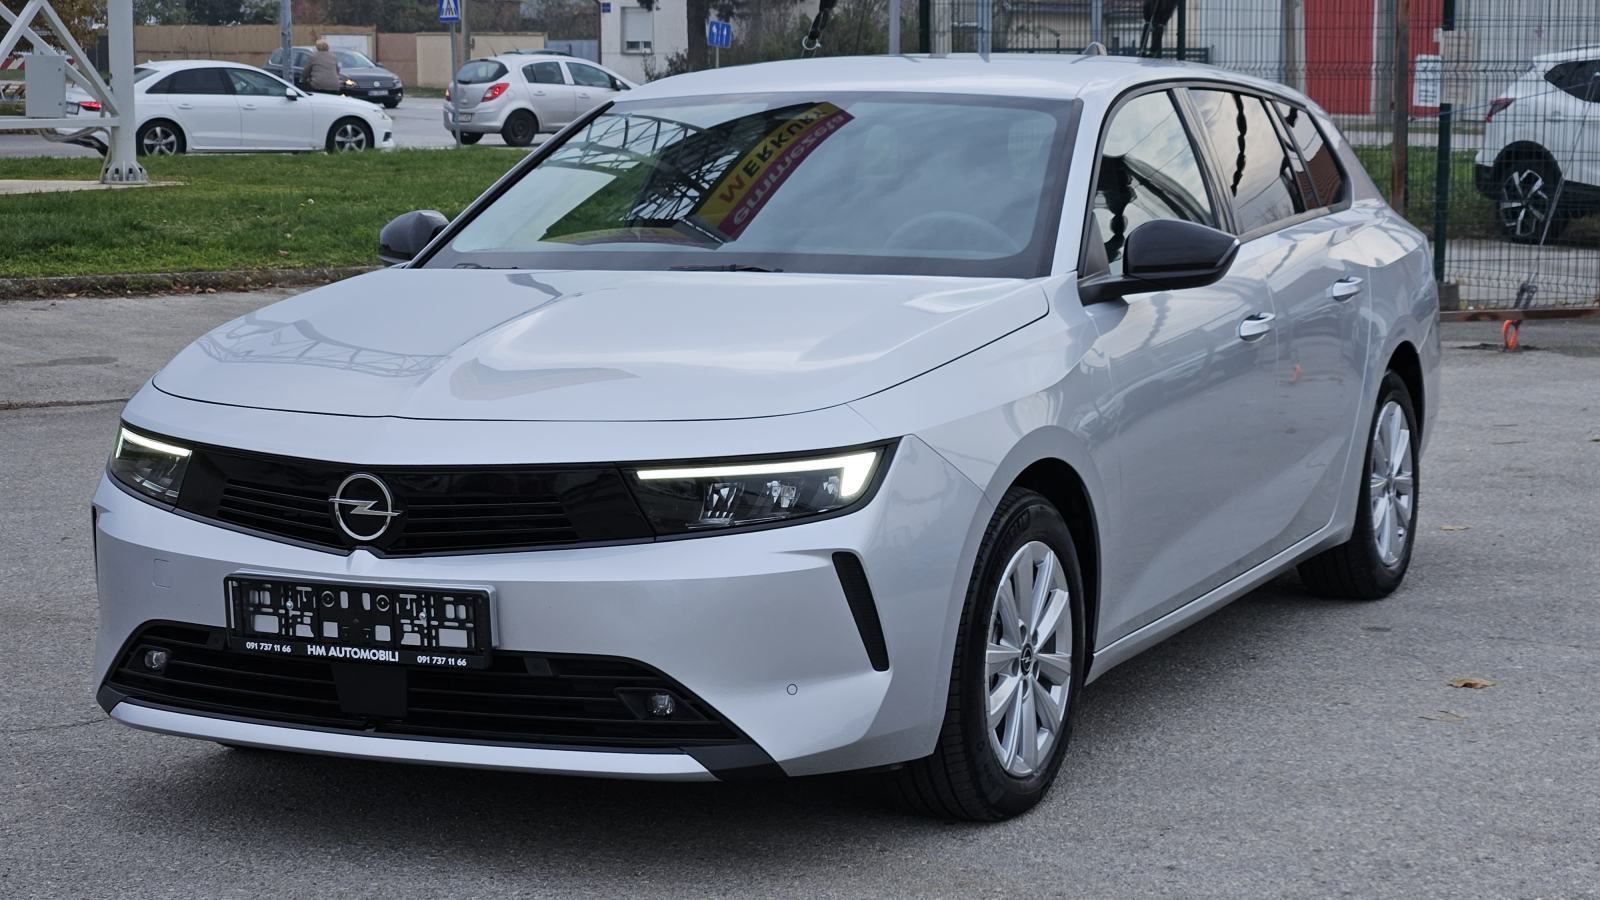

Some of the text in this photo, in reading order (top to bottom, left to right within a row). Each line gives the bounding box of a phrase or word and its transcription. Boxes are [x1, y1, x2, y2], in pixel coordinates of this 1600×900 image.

[246, 641, 292, 653] 091 737 11 66
[307, 644, 399, 662] HM AUTOMOBILI
[417, 655, 467, 667] 091 737 11 66
